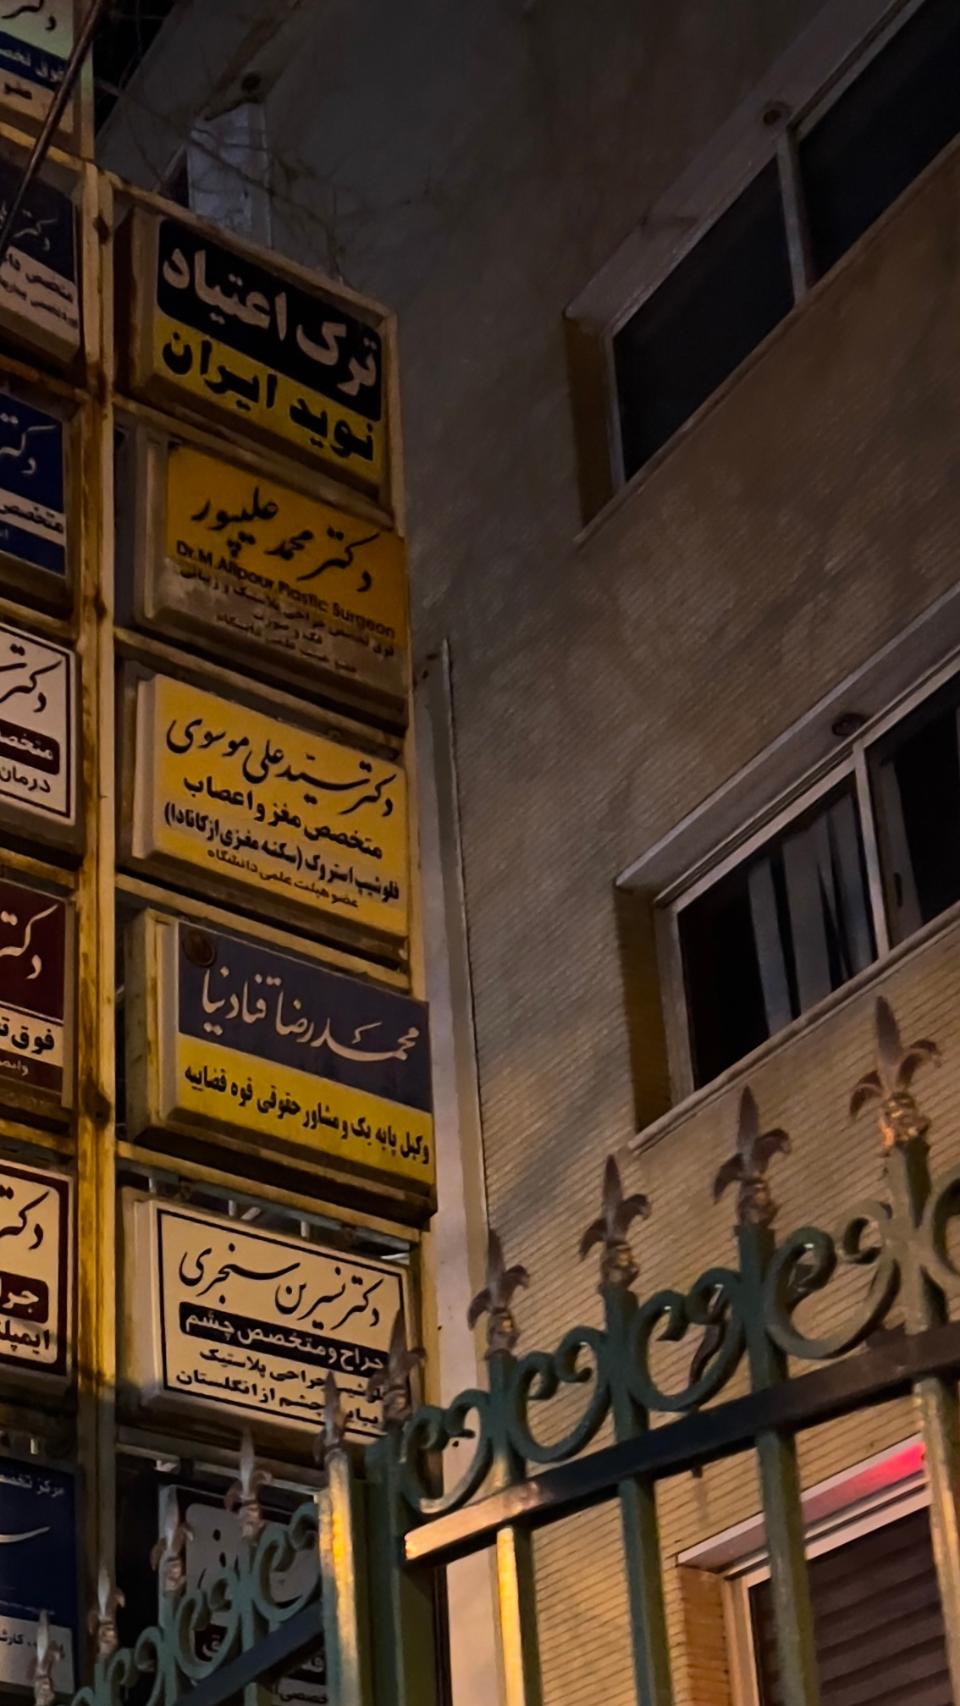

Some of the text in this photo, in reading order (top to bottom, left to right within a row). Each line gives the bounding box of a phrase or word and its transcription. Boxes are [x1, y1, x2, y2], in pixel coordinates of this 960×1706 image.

[11, 209, 56, 250] دکتر
[163, 249, 286, 339] اعتیاد
[296, 322, 376, 395] ترک
[162, 332, 373, 460] نوید ایران
[191, 487, 379, 592] دکتر محمد علیپور
[277, 580, 328, 612] Plastic
[332, 602, 395, 639] Surgeon
[166, 718, 396, 816] دکتر علی موسوی
[183, 776, 382, 858] متخصص مغز و اعصاب
[207, 849, 358, 907] عضو علمی دانشگاه
[219, 829, 399, 902] فلوشیپ مغزی
[11, 1025, 54, 1054] فوق
[184, 1065, 226, 1092] قضاییه
[230, 1077, 252, 1106] قوه
[256, 1085, 300, 1119] حقوقی
[302, 1102, 339, 1129] مشاور
[341, 1120, 348, 1139] و
[375, 1125, 396, 1156] پایه
[400, 1132, 429, 1164] وکیل
[178, 1243, 383, 1330] دکتر نسرین سنجری
[185, 1314, 337, 1363] و متخصص چشم
[200, 1348, 265, 1377] پلاستیک
[176, 1369, 275, 1403] از انگلستان
